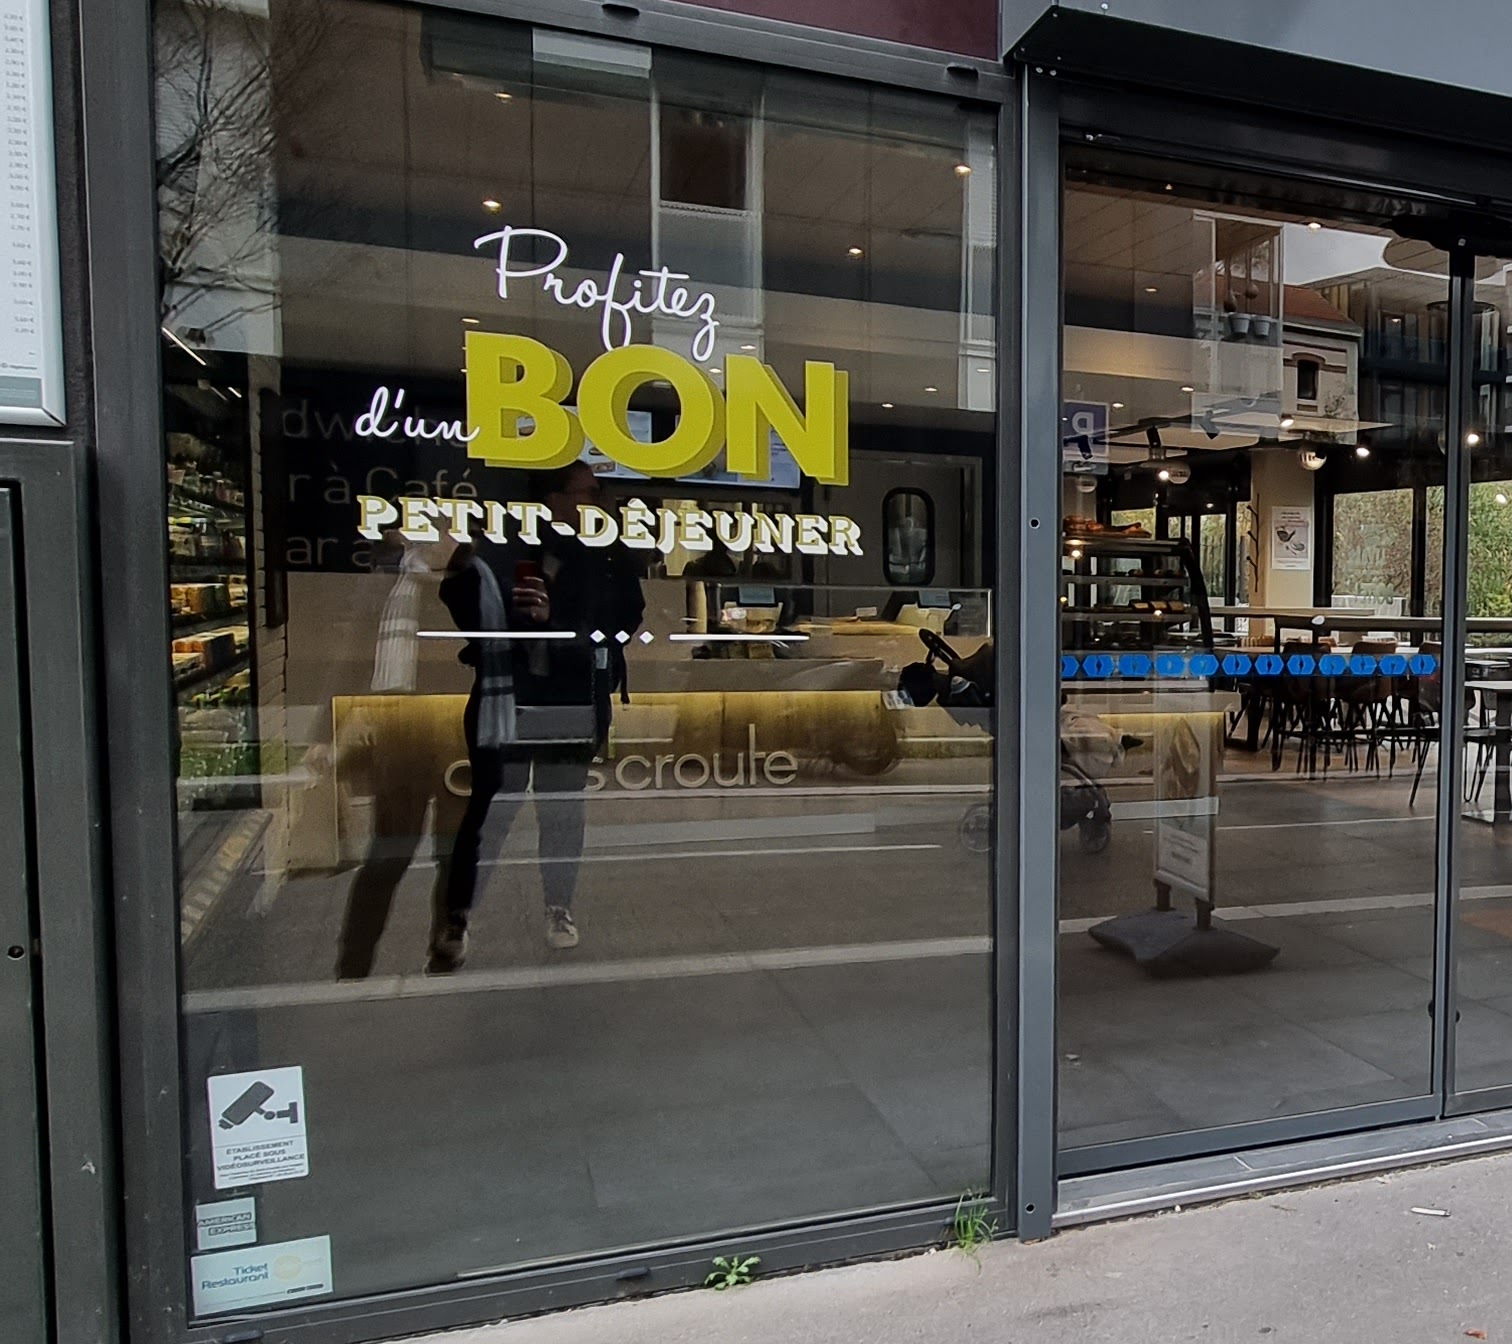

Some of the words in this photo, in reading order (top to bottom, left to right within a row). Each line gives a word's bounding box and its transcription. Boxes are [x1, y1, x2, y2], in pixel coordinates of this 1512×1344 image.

[473, 224, 720, 362] Profitez
[353, 385, 480, 443] d'un
[464, 330, 850, 487] BON
[201, 1272, 270, 1291] Restaurant
[232, 1262, 269, 1276] Ticket
